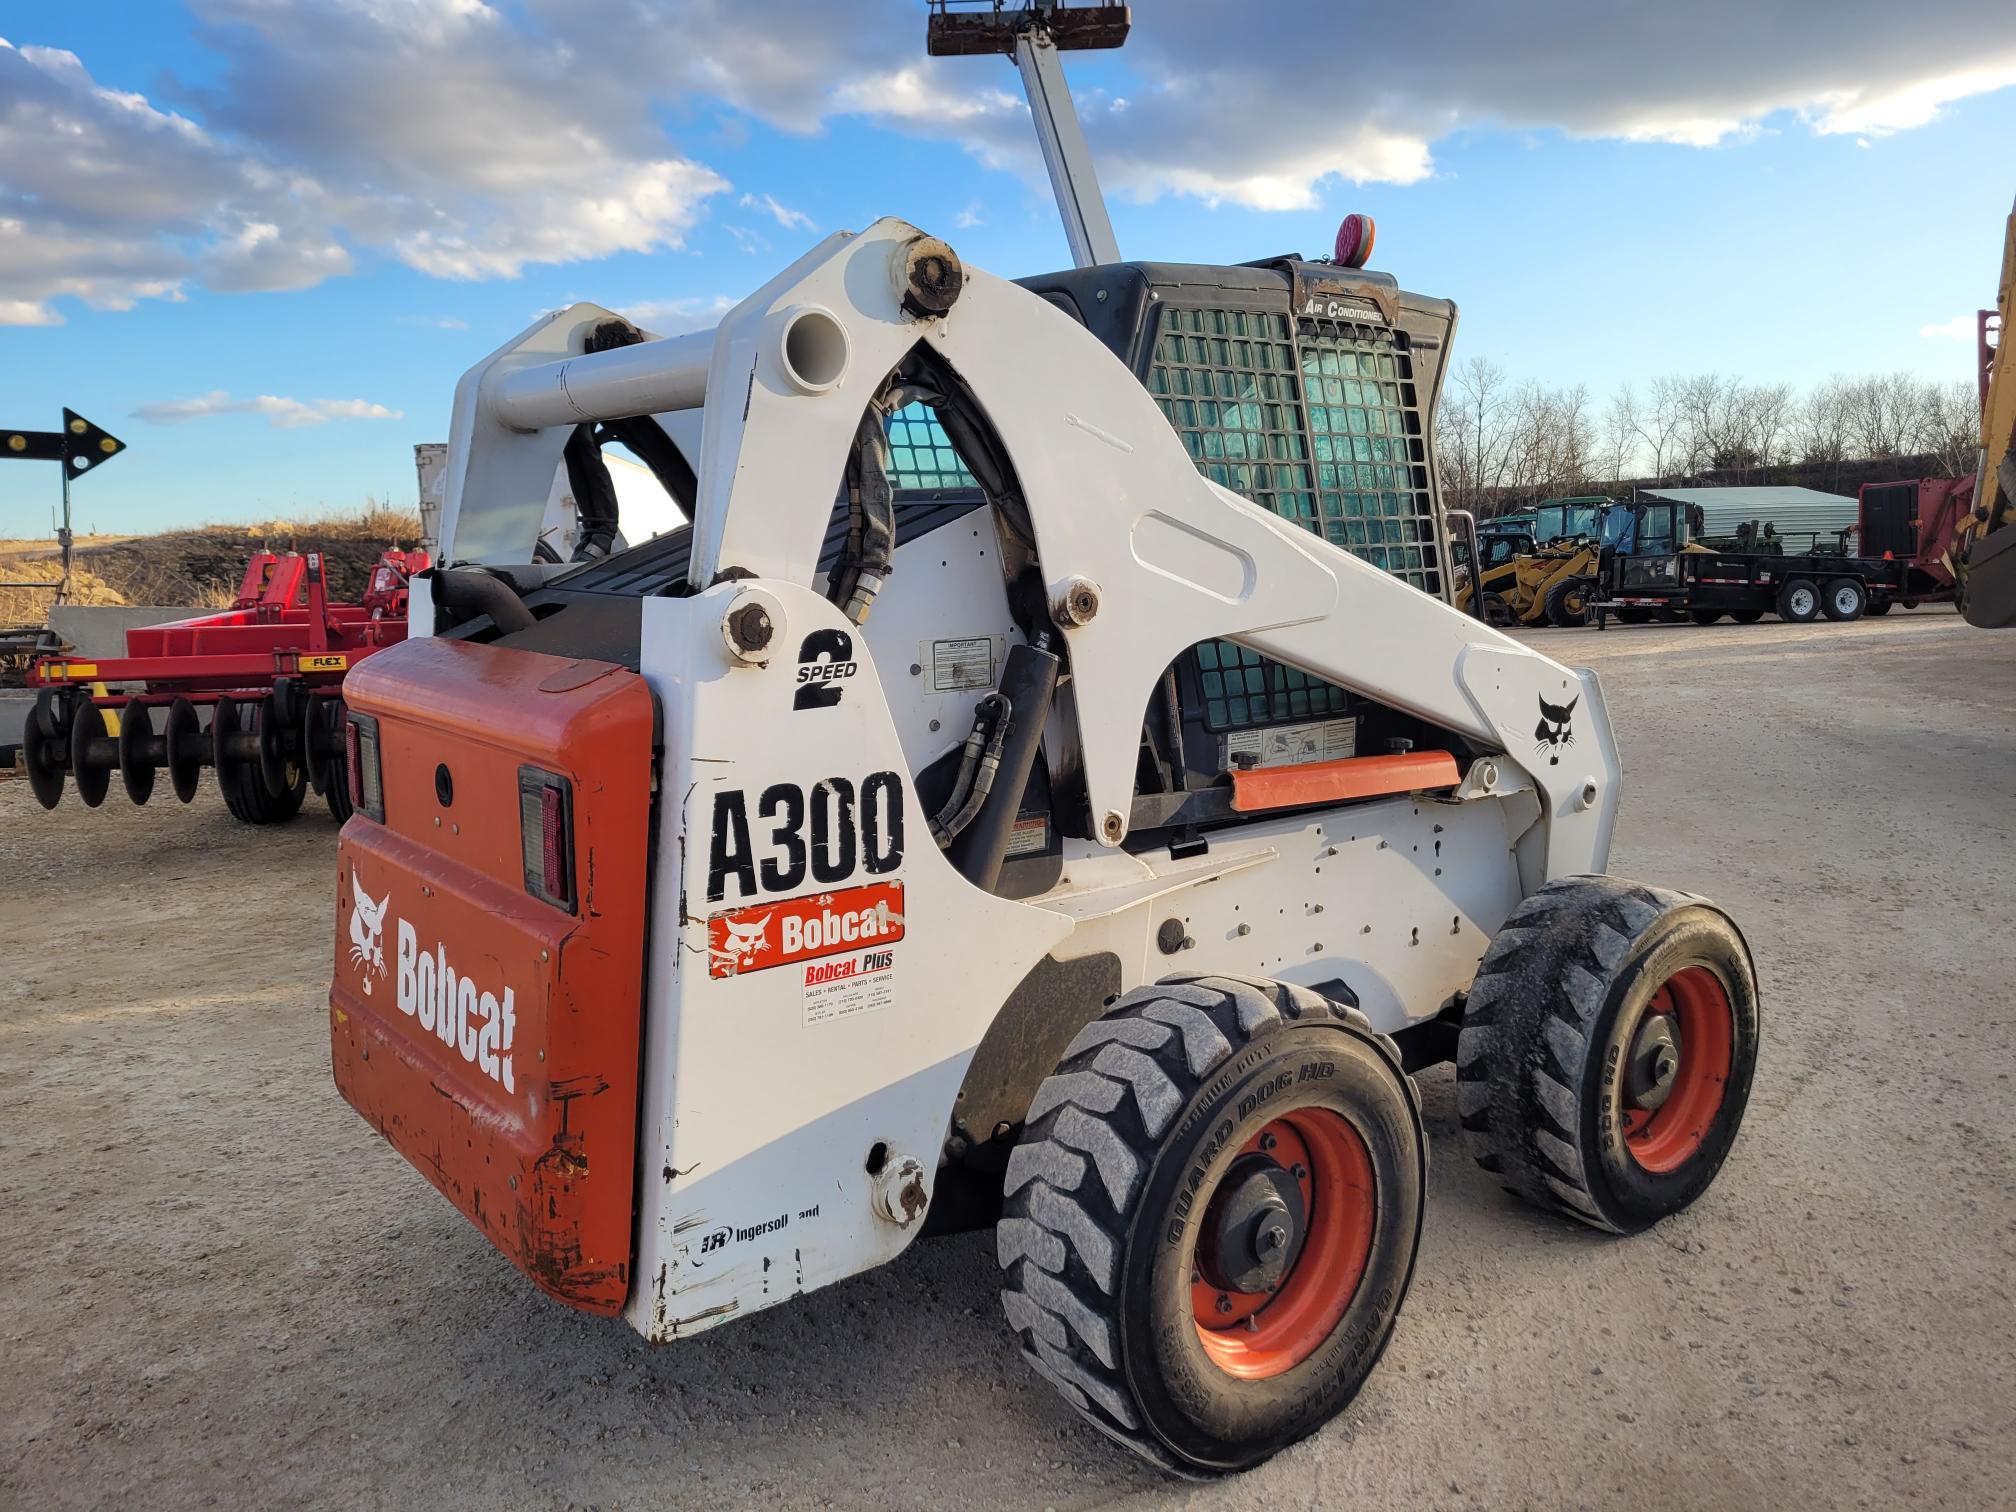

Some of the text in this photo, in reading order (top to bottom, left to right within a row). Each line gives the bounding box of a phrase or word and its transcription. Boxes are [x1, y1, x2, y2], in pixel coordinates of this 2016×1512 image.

[1328, 301, 1383, 321] CONDITIONED
[313, 657, 341, 666] FLEX
[793, 628, 852, 711] 2
[797, 662, 857, 683] SPEED
[707, 771, 904, 903] A300
[781, 900, 890, 955] Bobcat
[805, 952, 893, 985] Bobcat Plus
[805, 973, 893, 998] SALES RENTAL PARTS SERVICE
[397, 917, 516, 1095] Bobcat
[1168, 1061, 1335, 1246] GUARD DOG HD
[736, 1213, 788, 1242] Ingersoll
